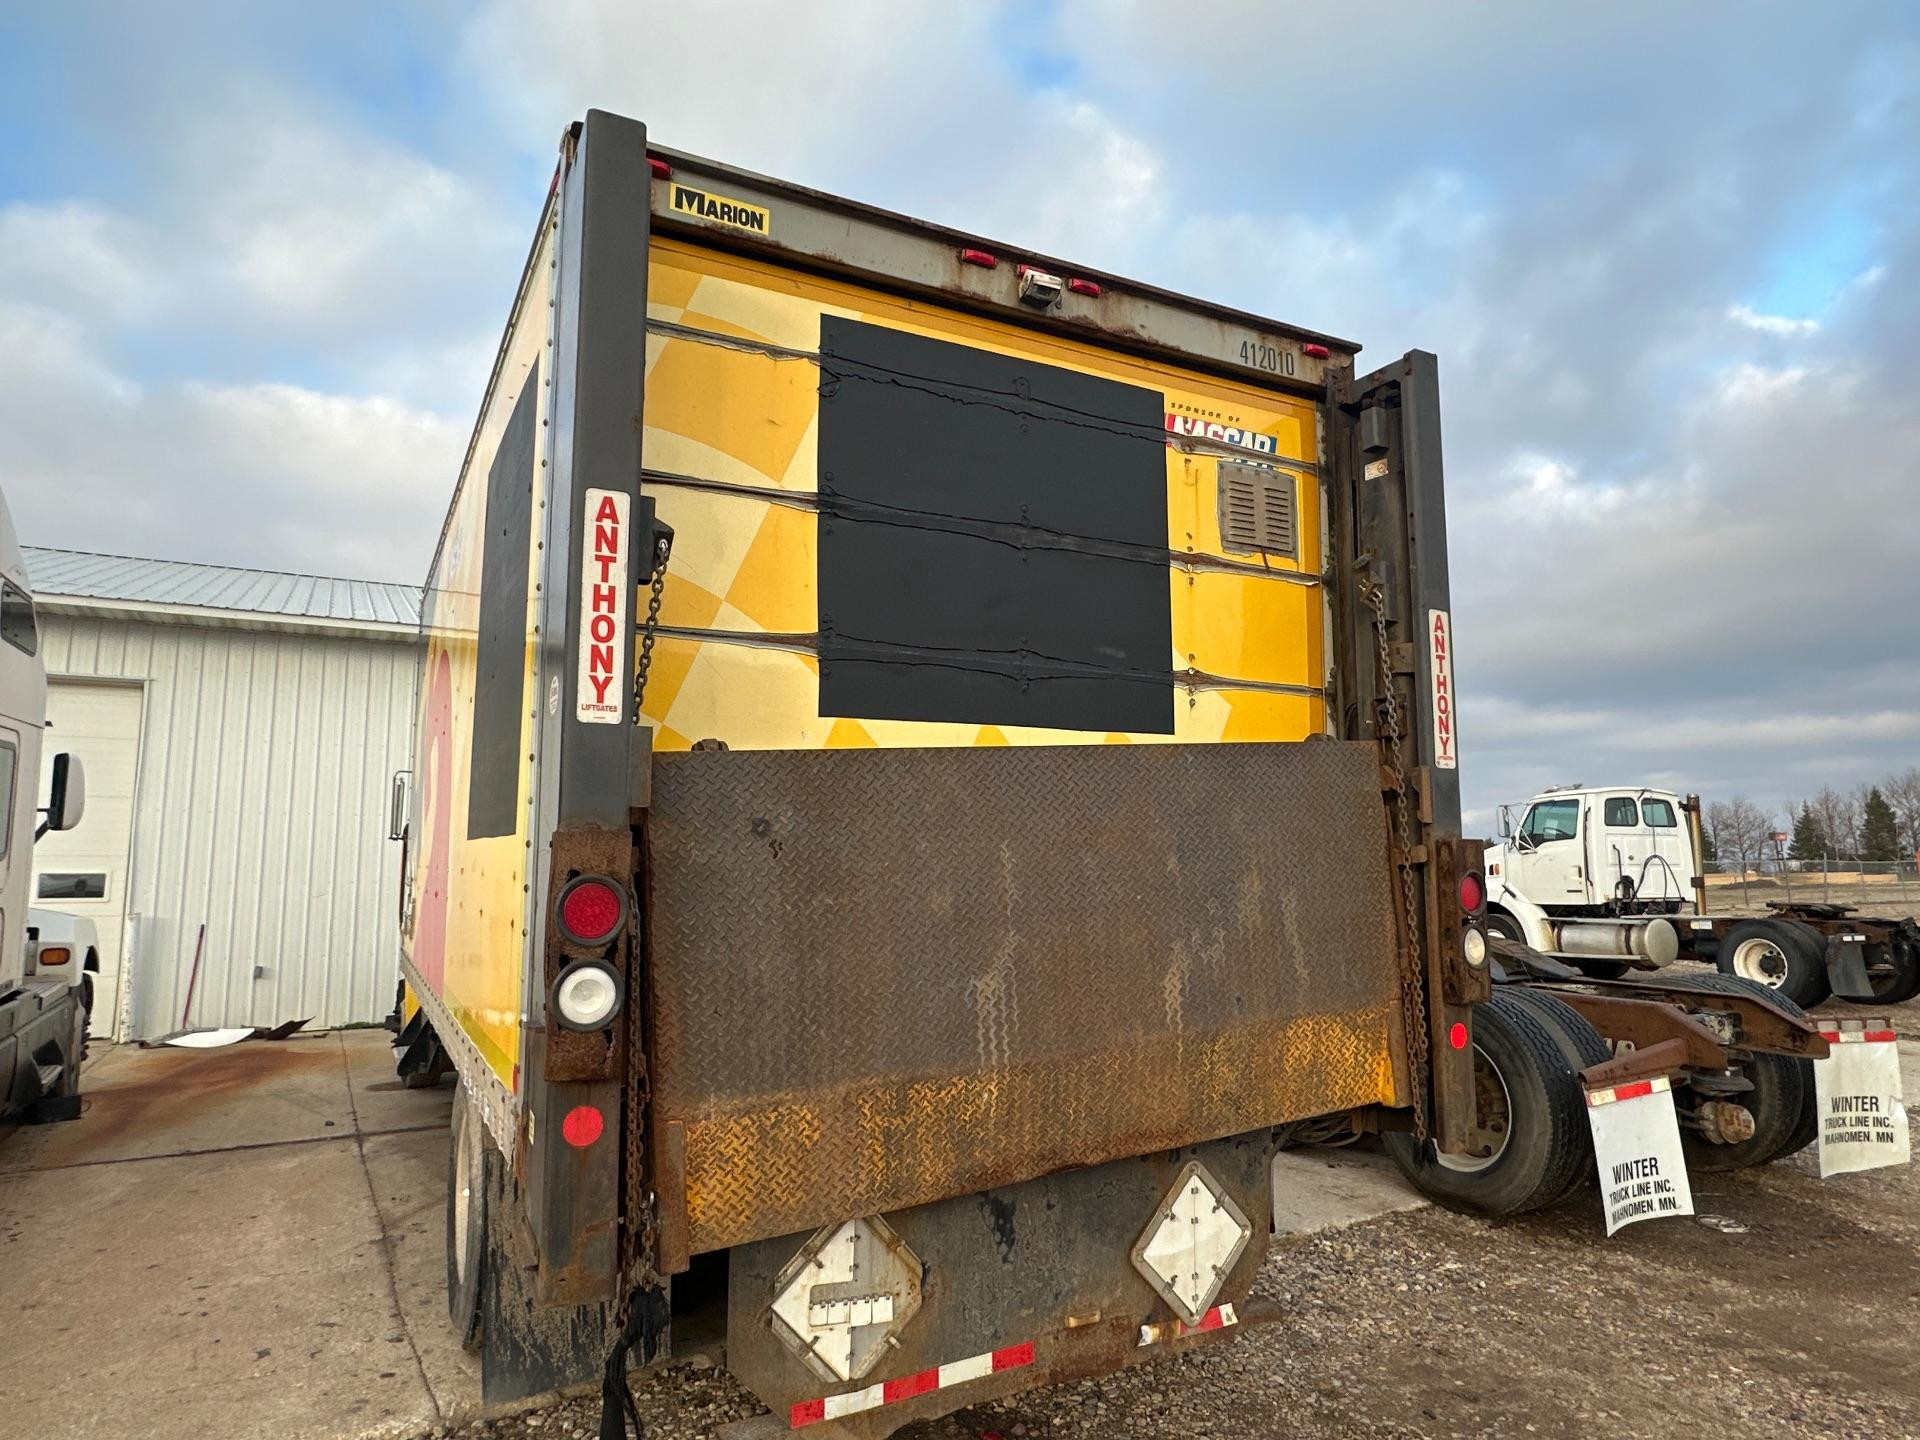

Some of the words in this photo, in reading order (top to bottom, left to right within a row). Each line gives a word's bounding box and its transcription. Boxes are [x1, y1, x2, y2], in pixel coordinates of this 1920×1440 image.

[674, 186, 764, 231] MARION
[1239, 340, 1295, 376] 412010
[1170, 402, 1222, 419] SPONSOR
[1228, 415, 1241, 423] OF
[588, 495, 620, 704] ANTHONY
[1433, 614, 1450, 756] ANTHONY
[581, 703, 618, 713] LIFTGATES
[1831, 1095, 1880, 1114] WINTER
[1824, 1116, 1847, 1130] TRUCK
[1849, 1116, 1870, 1128] LINE
[1872, 1116, 1895, 1129] INC.
[1876, 1131, 1894, 1144] MN
[1612, 1156, 1660, 1185] WINTER
[1609, 1186, 1630, 1207] TRUCK
[1631, 1181, 1651, 1198] LINE
[1653, 1179, 1675, 1194] INC.
[1658, 1196, 1677, 1212] MN
